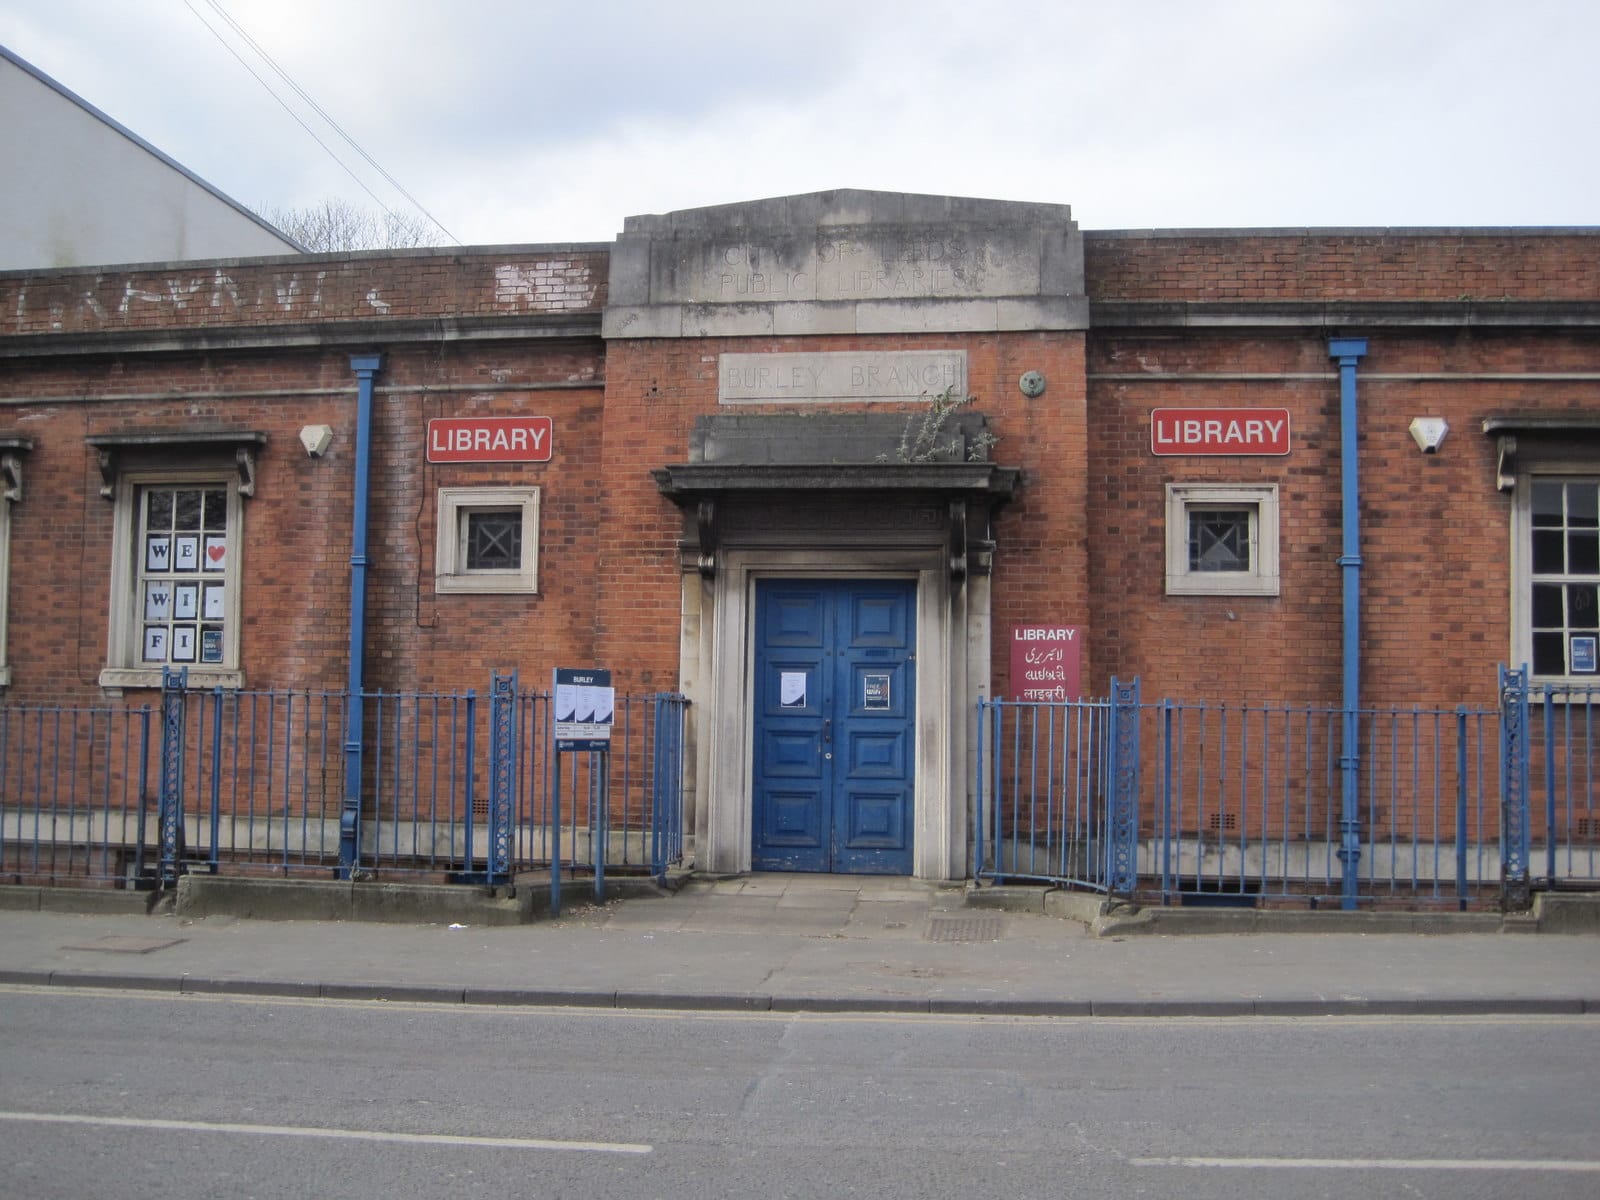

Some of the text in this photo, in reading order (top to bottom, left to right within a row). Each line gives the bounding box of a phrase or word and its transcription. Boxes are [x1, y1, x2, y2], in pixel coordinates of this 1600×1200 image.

[723, 240, 966, 266] CITY OF LEEDS
[720, 267, 968, 295] PUBLIC LIBRARIES
[728, 363, 957, 389] BURLEY BRANCH
[432, 428, 546, 451] LIBRARY
[1157, 420, 1284, 443] LIBRARY
[152, 545, 192, 558] WE
[151, 635, 188, 648] FI
[1015, 629, 1075, 641] LIBRARY
